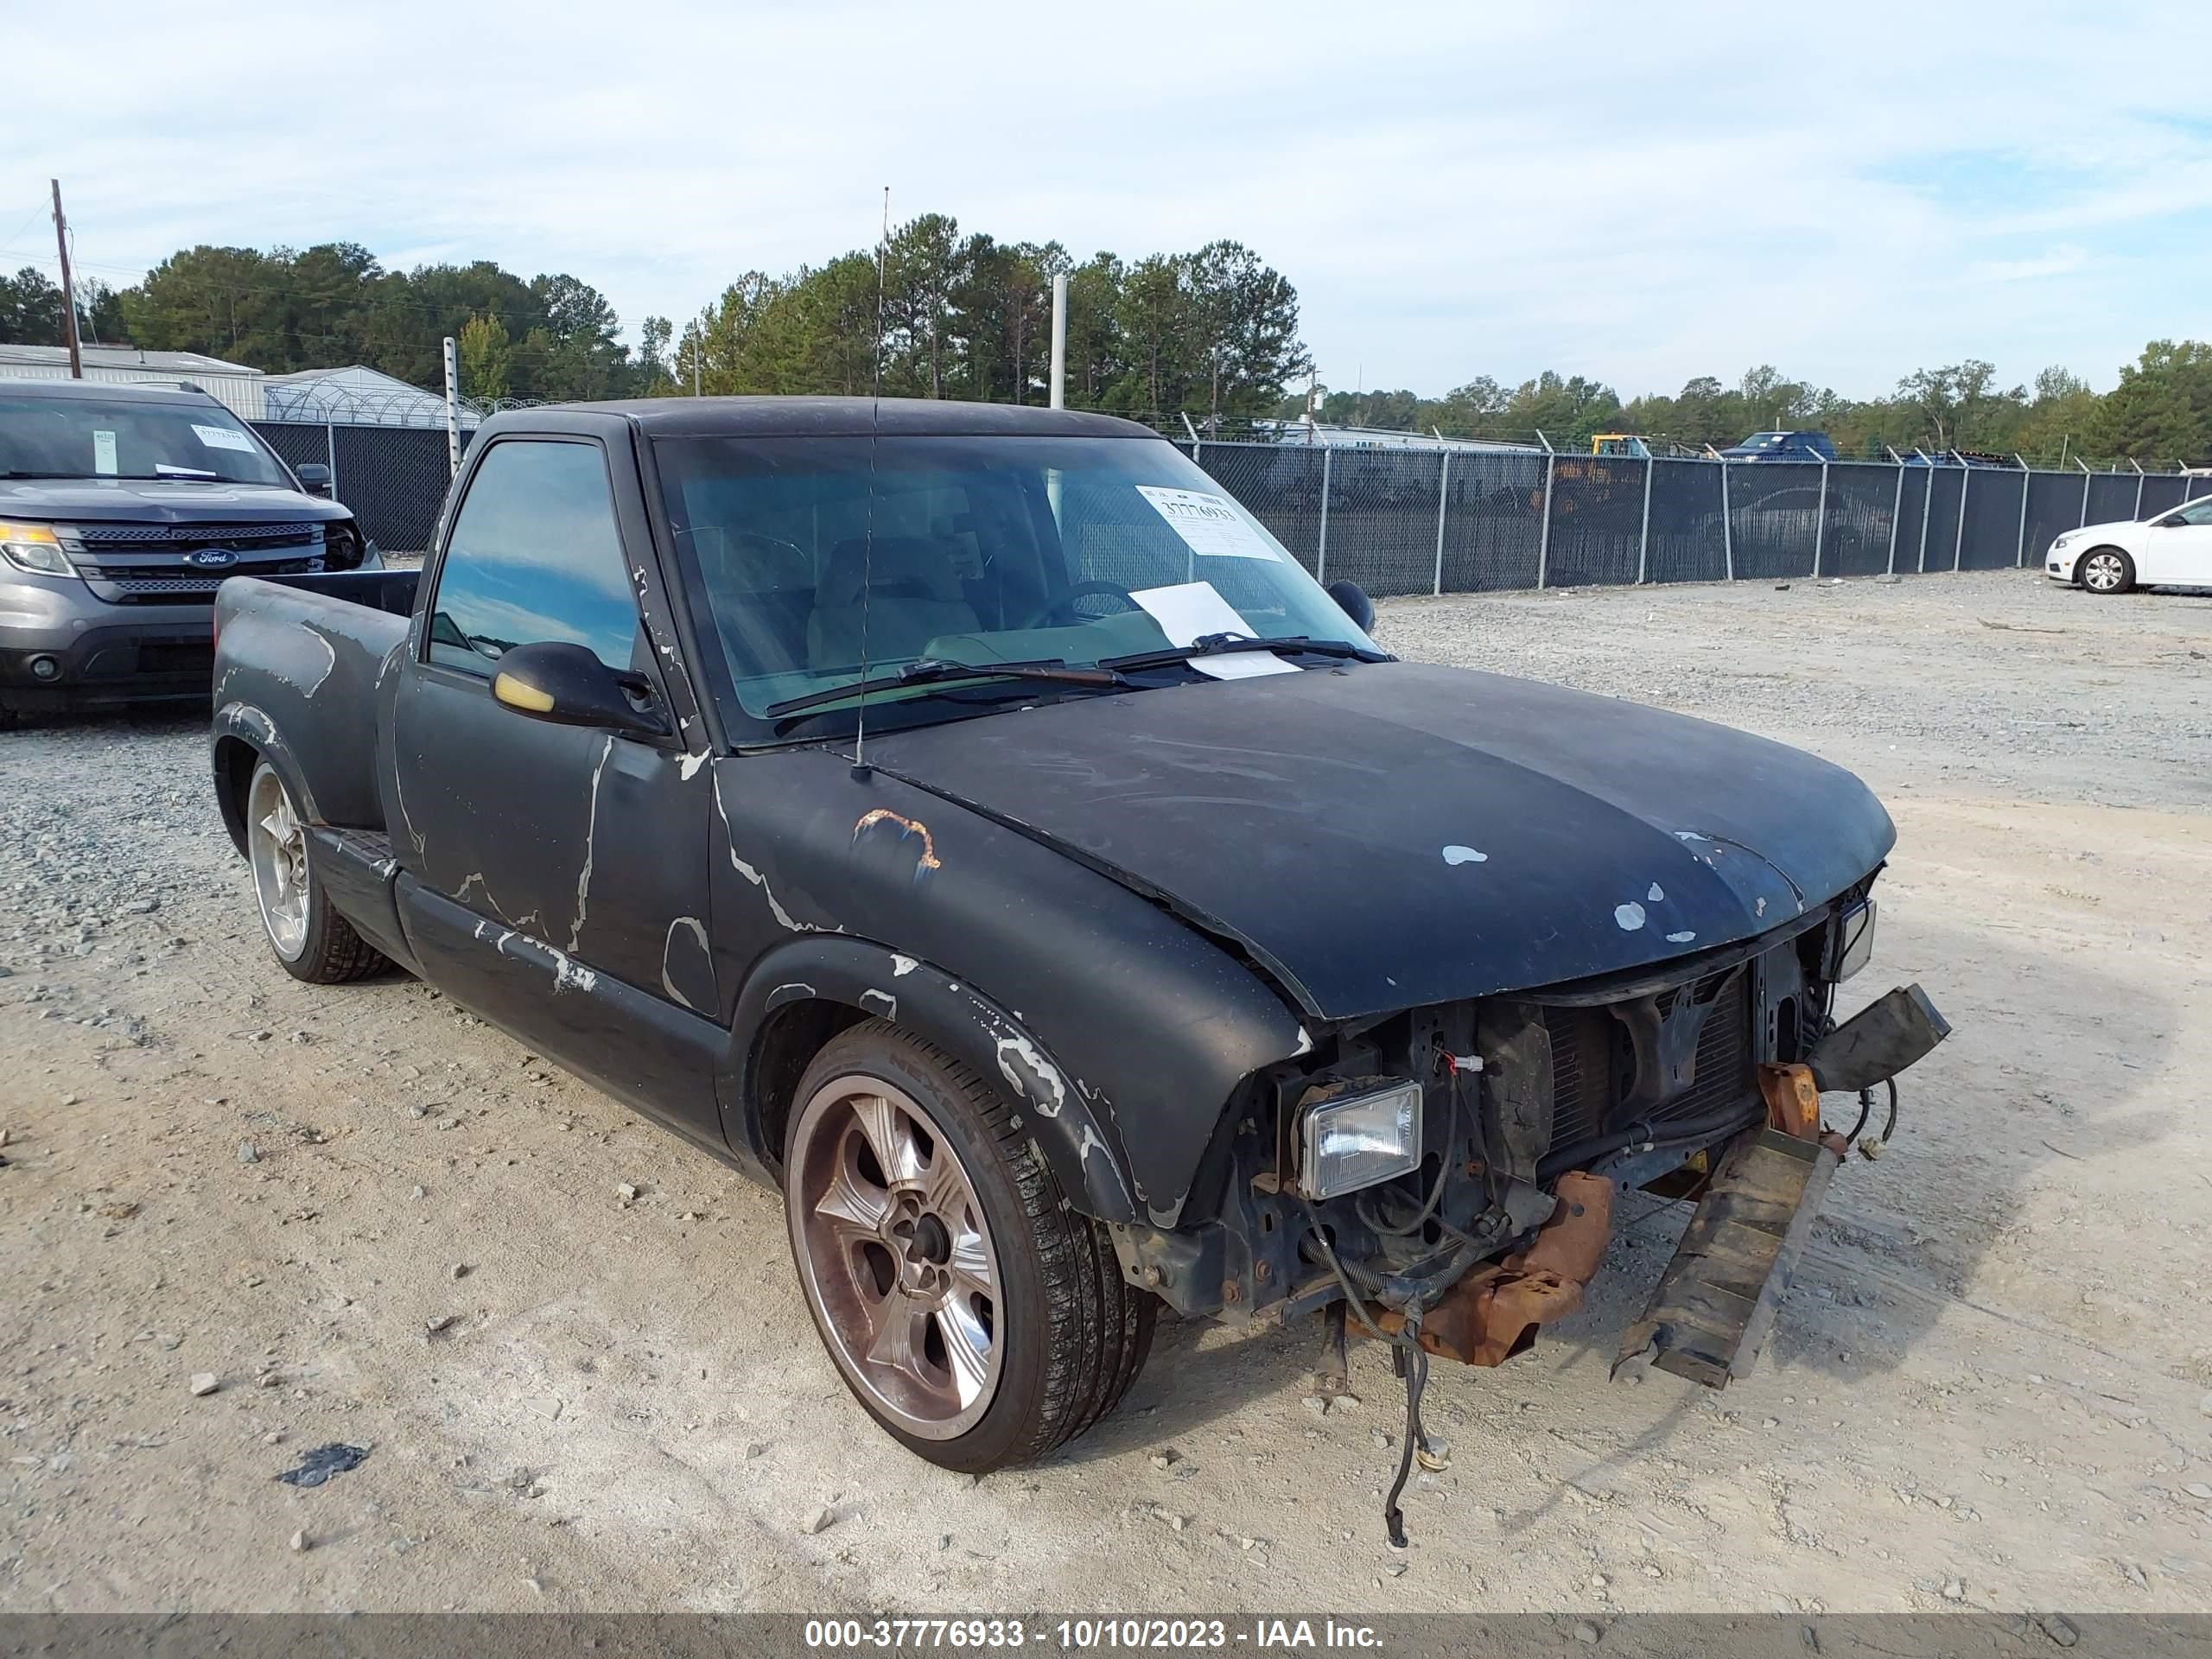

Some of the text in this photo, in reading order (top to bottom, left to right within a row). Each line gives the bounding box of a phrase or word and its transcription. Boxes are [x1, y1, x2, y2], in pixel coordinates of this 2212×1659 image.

[1161, 502, 1236, 521] 37776933
[200, 551, 227, 563] Ford
[889, 1052, 976, 1146] NEXEN
